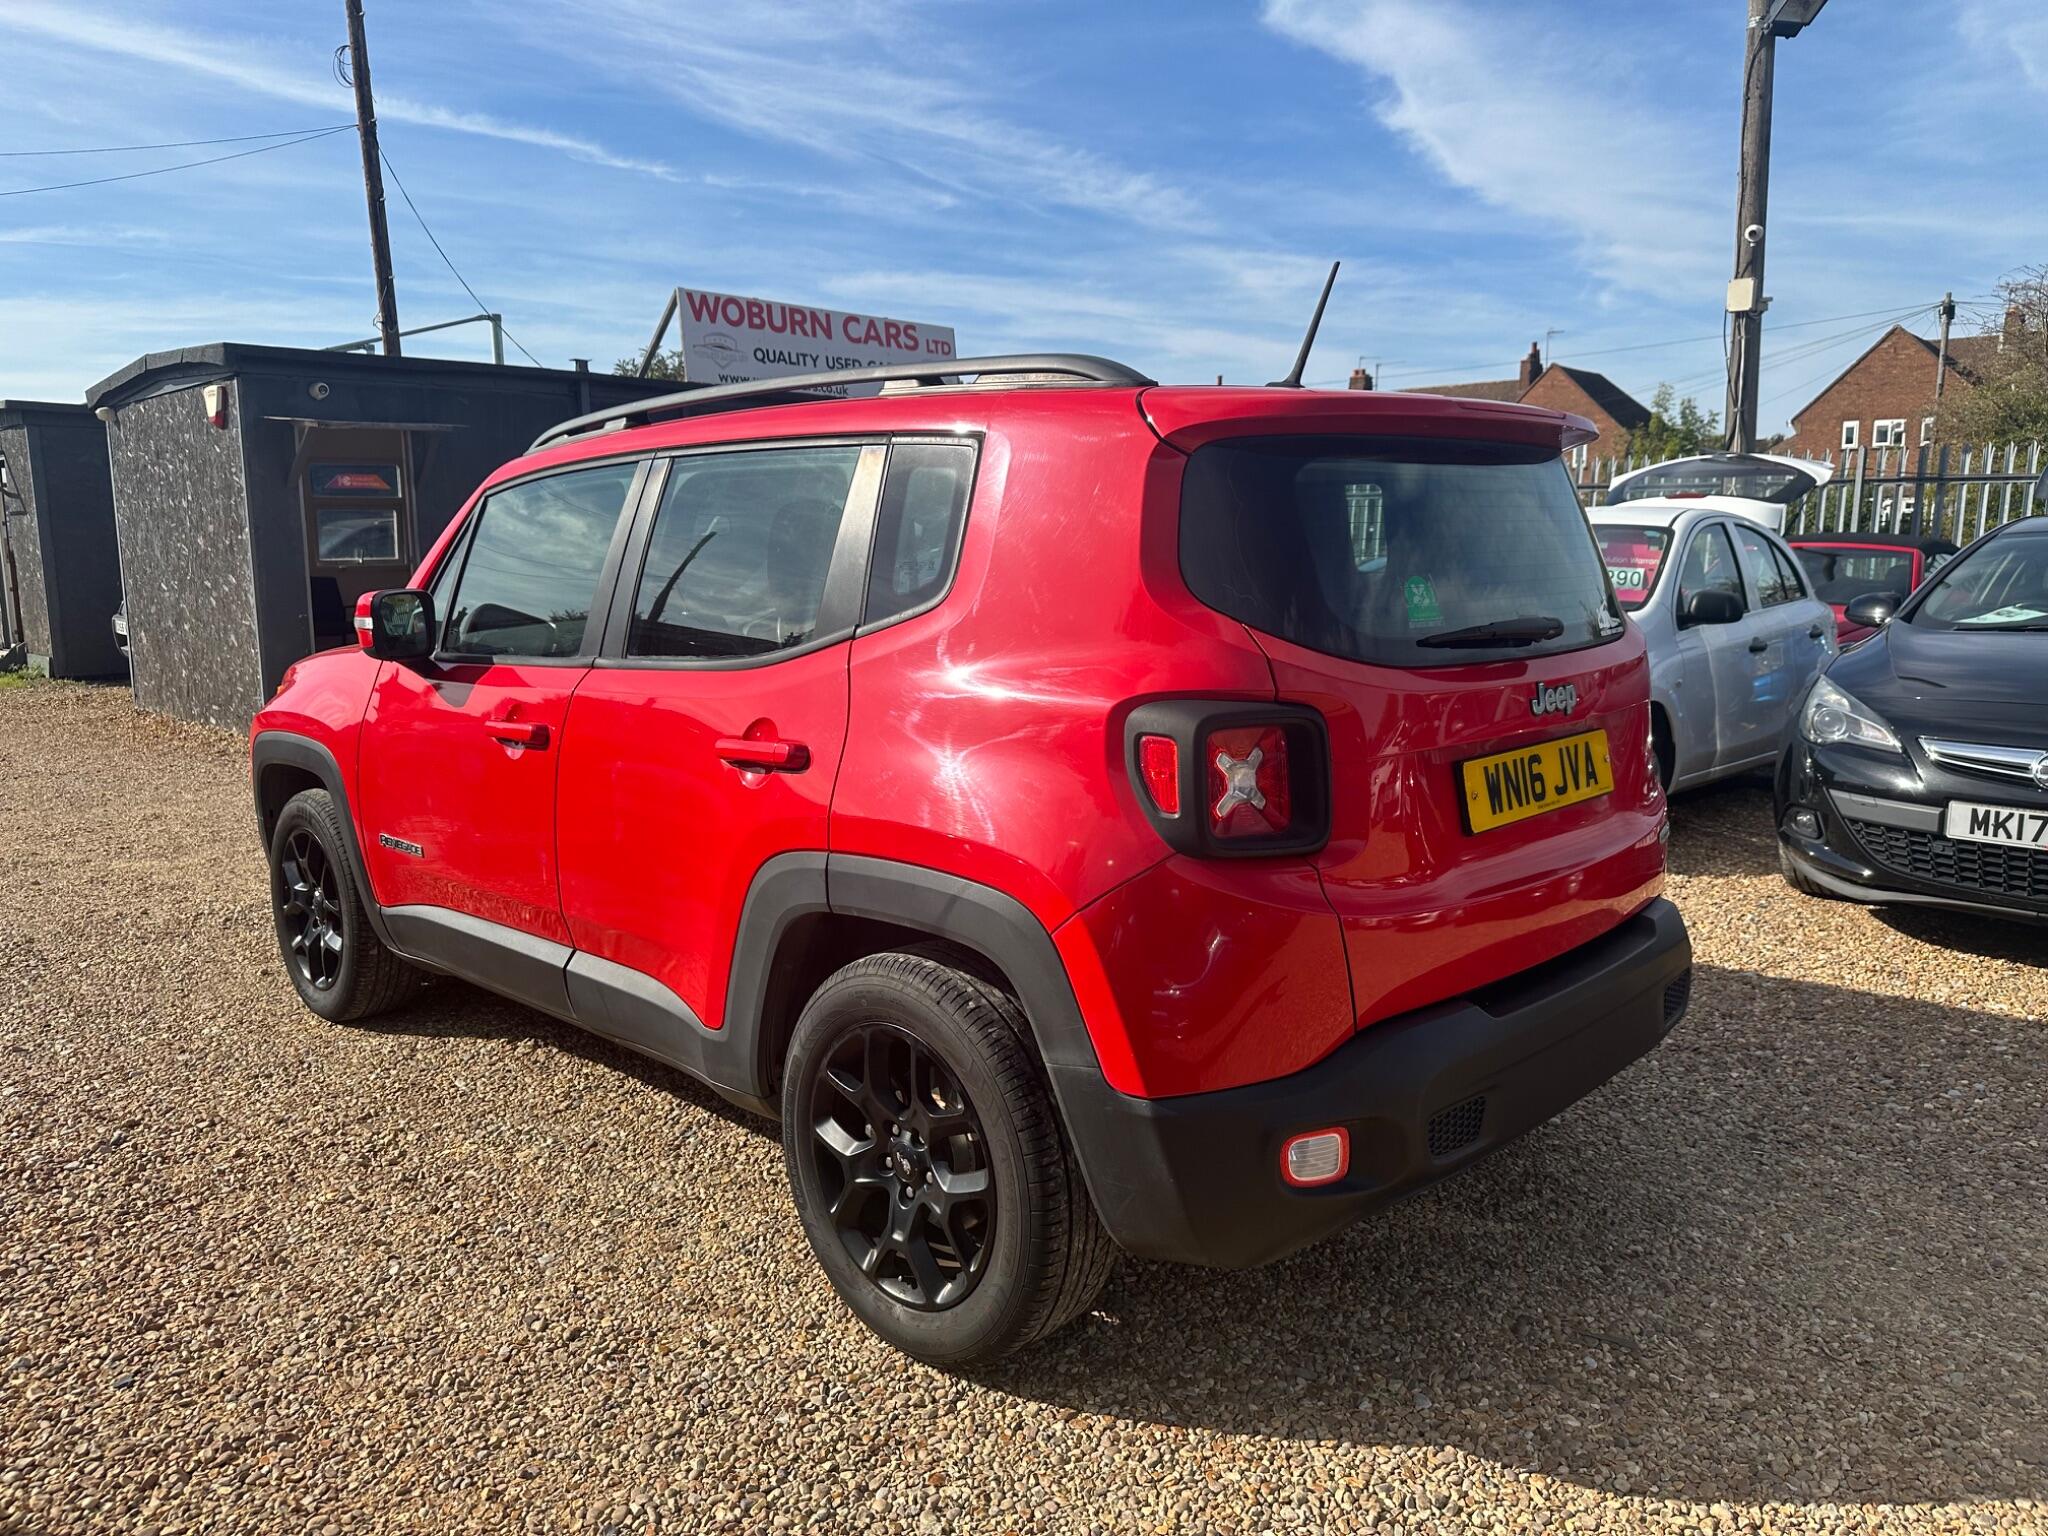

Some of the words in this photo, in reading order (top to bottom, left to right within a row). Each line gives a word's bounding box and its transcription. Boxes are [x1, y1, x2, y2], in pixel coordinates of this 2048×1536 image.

[686, 291, 833, 340] WOBURN
[842, 315, 919, 351] CARS
[926, 338, 951, 356] LTD
[753, 347, 819, 369] QUALITY
[826, 355, 862, 370] USED
[1532, 682, 1577, 715] Jeep
[1483, 754, 1546, 815] WN16
[1554, 741, 1599, 795] JVA
[1969, 807, 2048, 842] MK17
